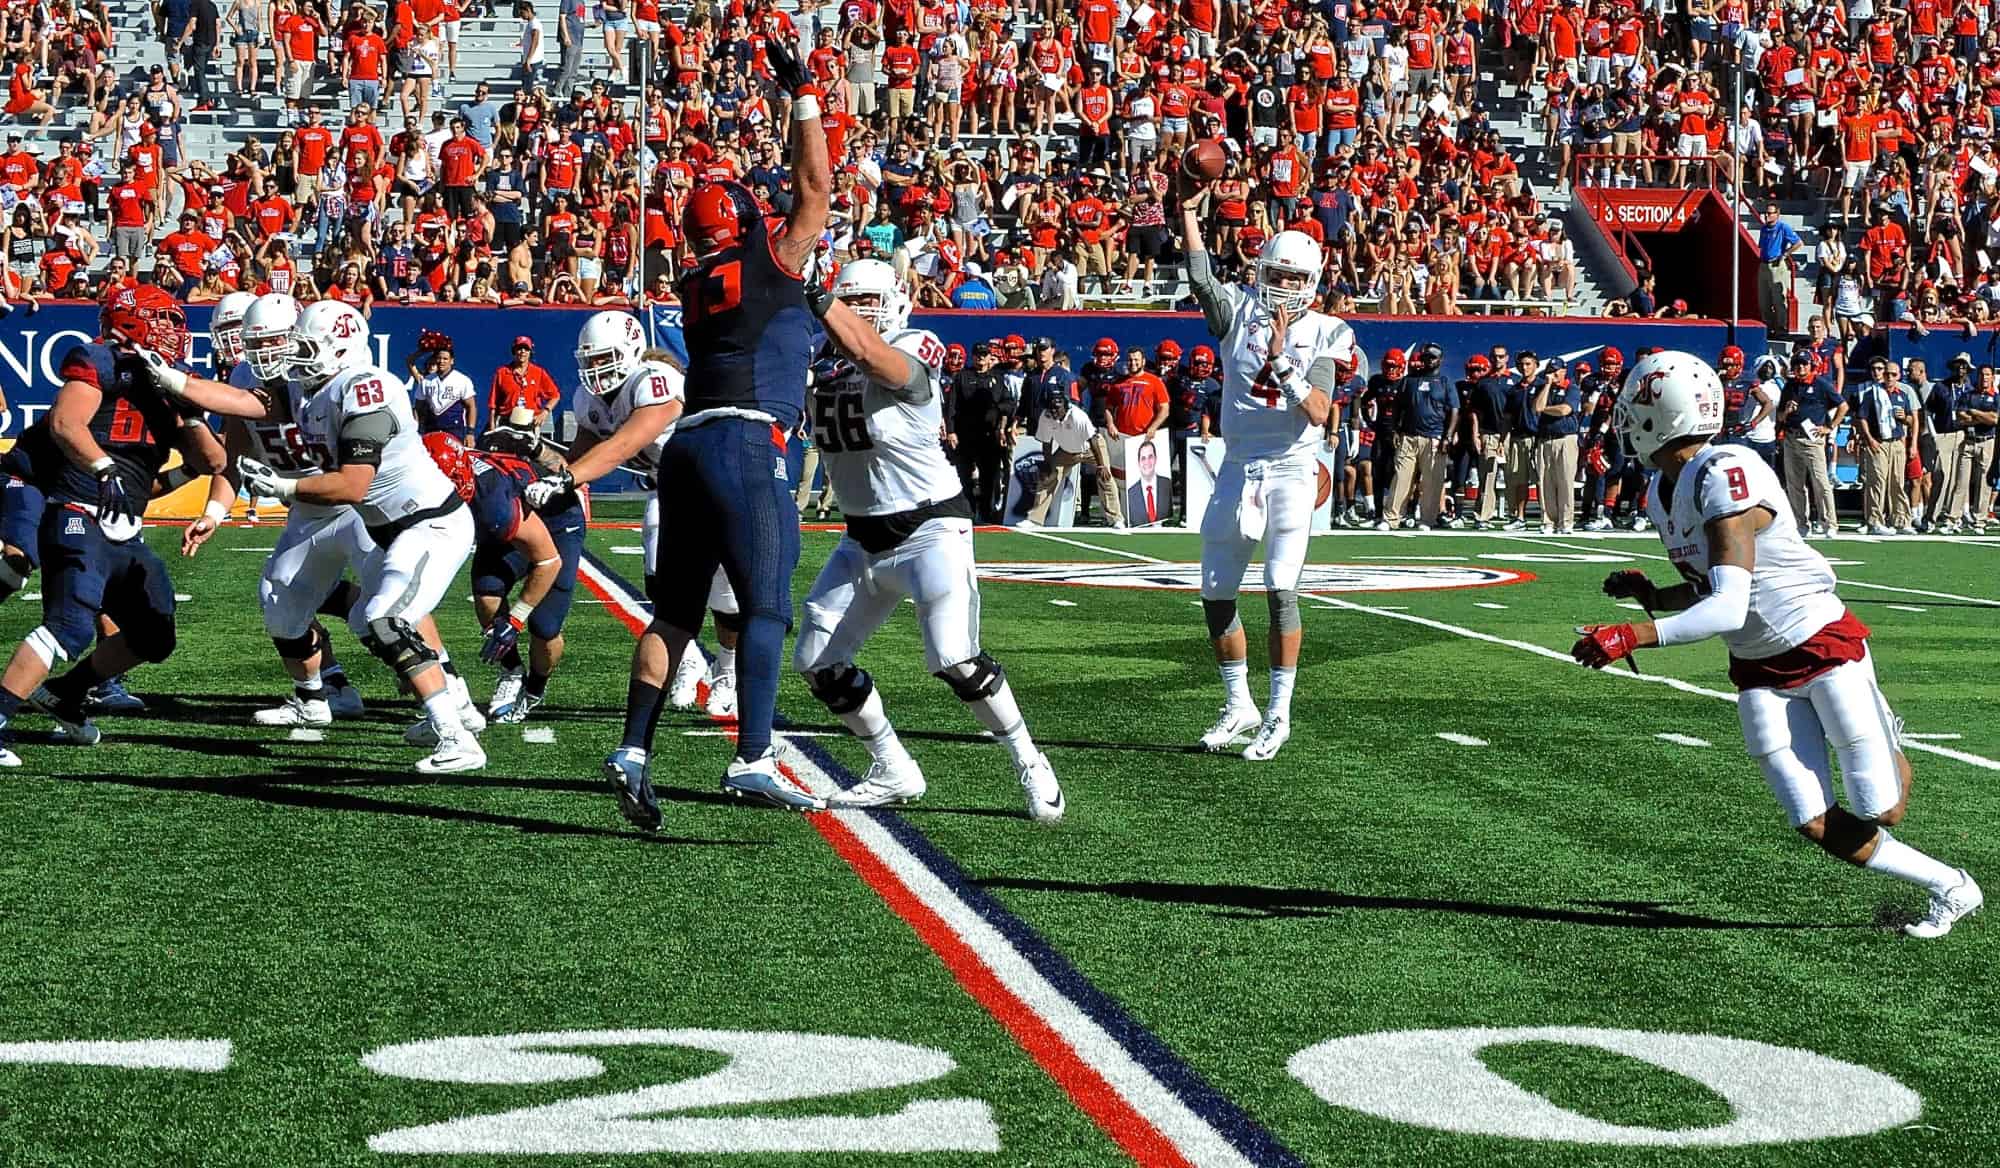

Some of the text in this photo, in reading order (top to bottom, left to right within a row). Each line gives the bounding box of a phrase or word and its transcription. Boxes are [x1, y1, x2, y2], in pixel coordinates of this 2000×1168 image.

[1604, 205, 1685, 223] 3 SECTION 4
[918, 335, 945, 369] 56
[354, 379, 385, 408] 63
[649, 376, 670, 399] 61
[1250, 359, 1283, 409] 4
[815, 393, 873, 453] 56
[1712, 402, 1719, 418] 9
[1723, 466, 1750, 502] 9
